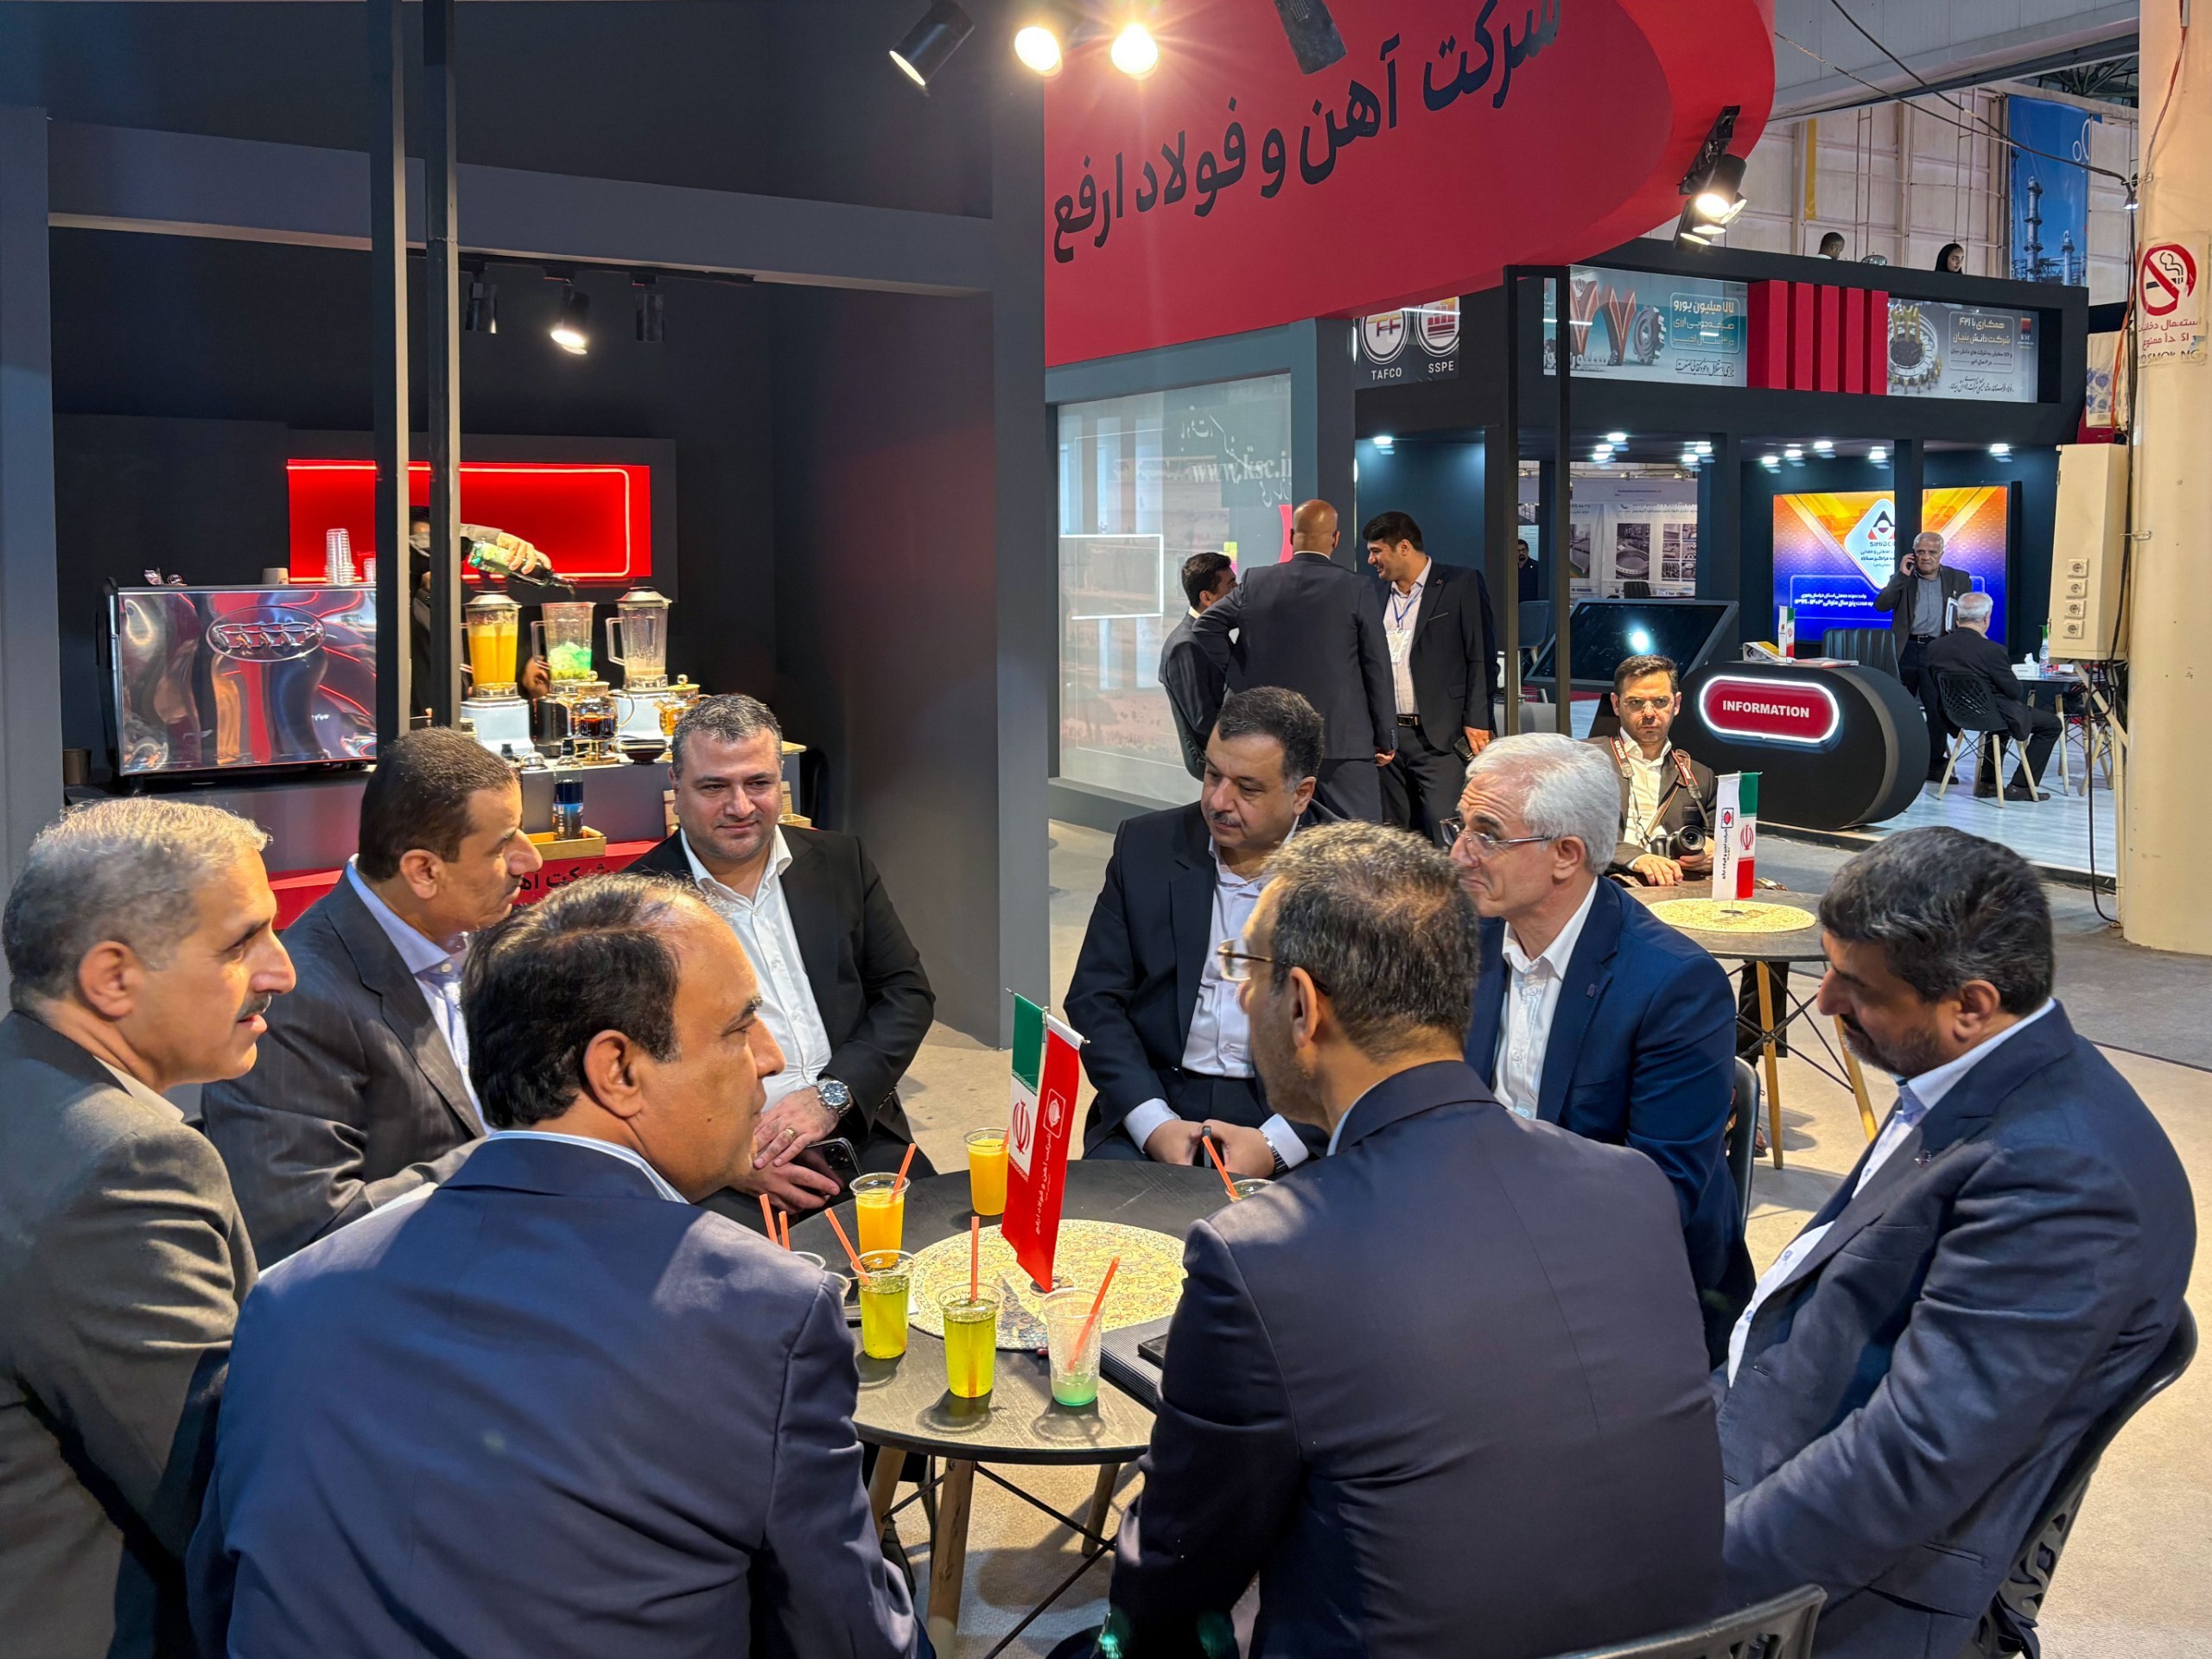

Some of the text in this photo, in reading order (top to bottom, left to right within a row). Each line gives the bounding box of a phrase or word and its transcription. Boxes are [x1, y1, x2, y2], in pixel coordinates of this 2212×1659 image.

[1300, 33, 1401, 185] آهن
[1136, 97, 1246, 217] فولاد
[1260, 128, 1286, 199] و
[1053, 152, 1123, 263] ارفع
[1674, 300, 1692, 313] یورو
[1694, 300, 1722, 314] میلیون
[1976, 318, 2005, 330] همکاری
[2161, 317, 2202, 331] استعمال
[1970, 333, 1987, 344] دانش
[1987, 334, 2011, 346] شرکت
[1370, 360, 1454, 380] TAFCO SSPE
[1723, 701, 1809, 718] INFORMATION
